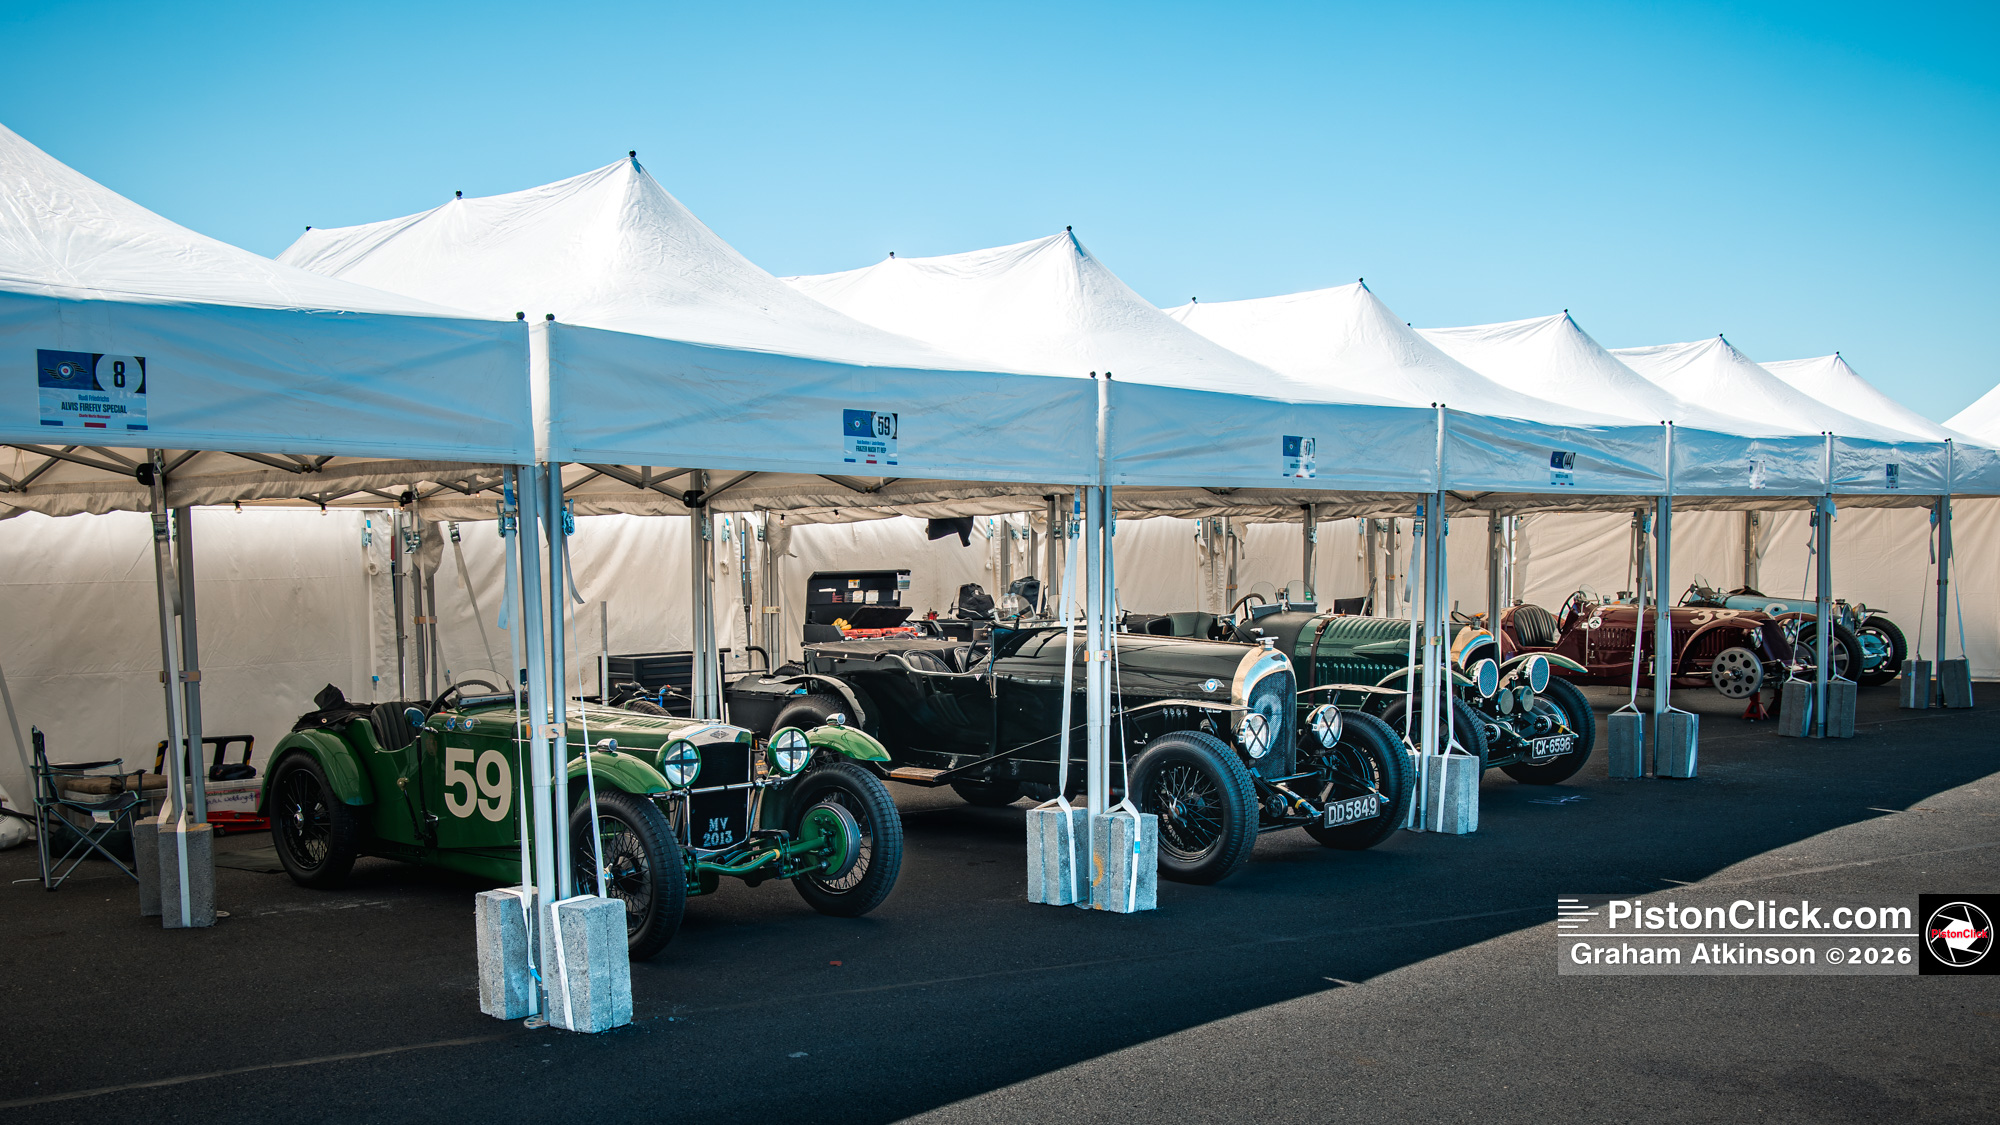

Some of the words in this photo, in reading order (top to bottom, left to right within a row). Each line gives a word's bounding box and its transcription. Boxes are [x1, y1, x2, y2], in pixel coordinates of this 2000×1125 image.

[113, 361, 126, 388] 8
[61, 401, 79, 411] ALVIS
[79, 402, 102, 413] FIREFLY
[102, 404, 128, 414] SPECIAL
[877, 416, 890, 436] 59
[444, 747, 512, 822] 59
[709, 817, 728, 831] MV
[703, 830, 733, 847] 2013
